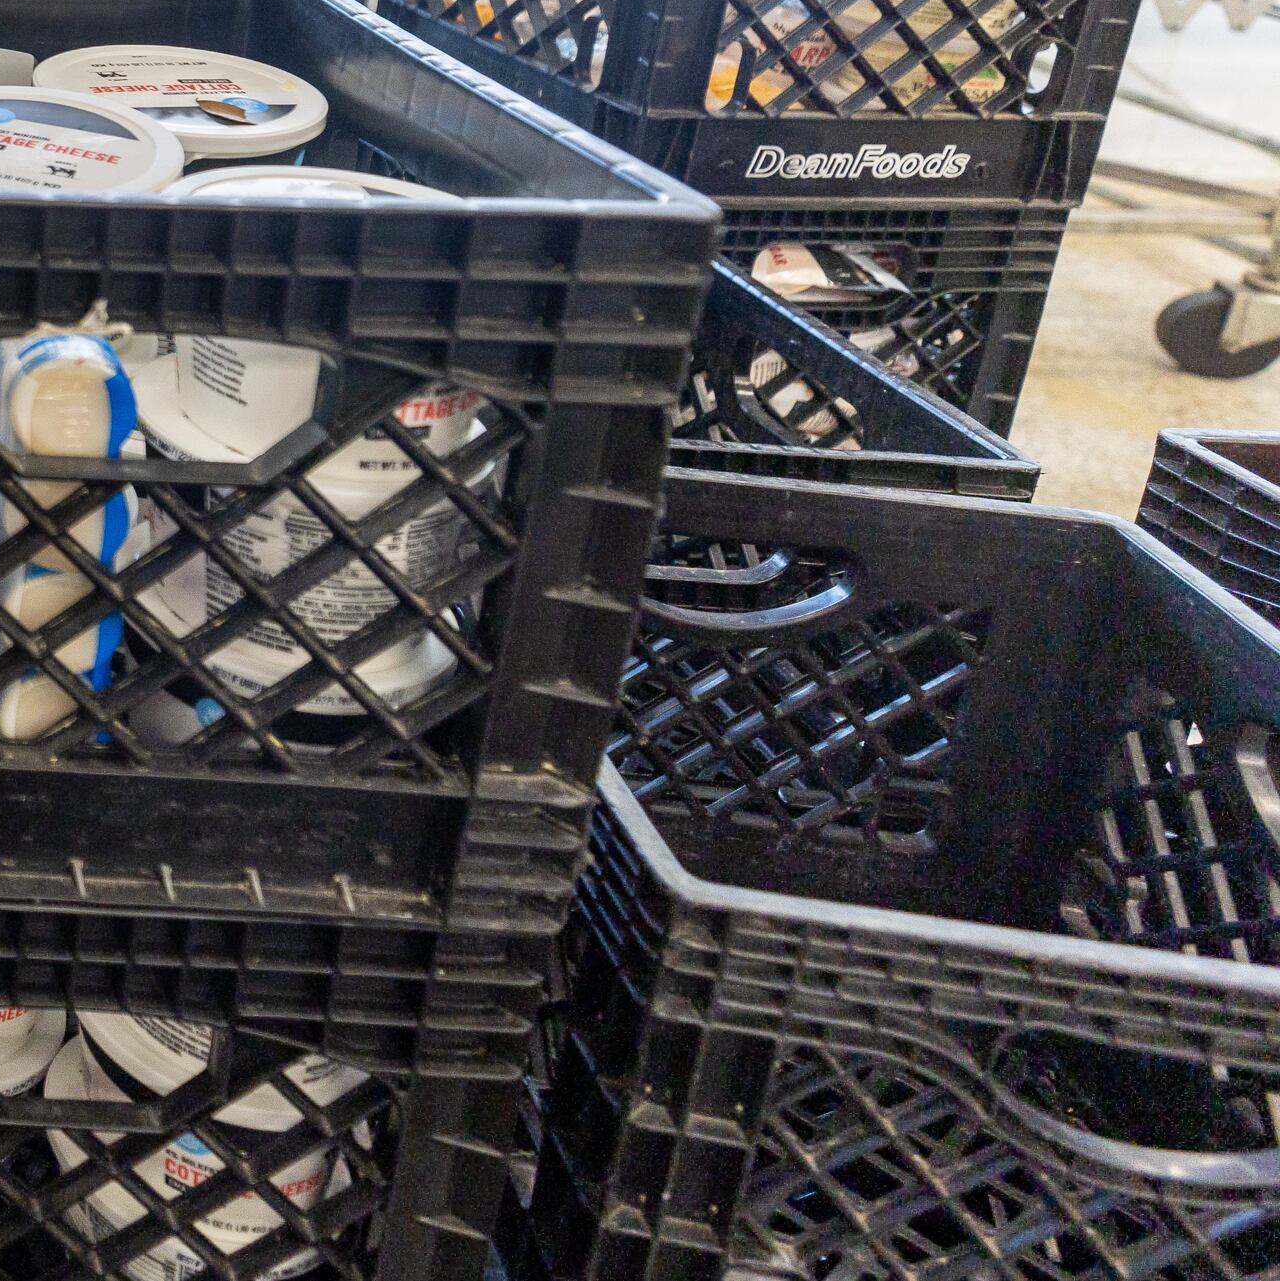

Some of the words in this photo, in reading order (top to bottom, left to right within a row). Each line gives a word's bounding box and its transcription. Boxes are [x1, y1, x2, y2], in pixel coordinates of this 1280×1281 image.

[790, 39, 834, 65] ARP
[89, 84, 162, 94] CHEESE
[162, 83, 242, 93] COTTAGE
[43, 143, 123, 165] CHEESE
[745, 144, 971, 180] DeanFoods
